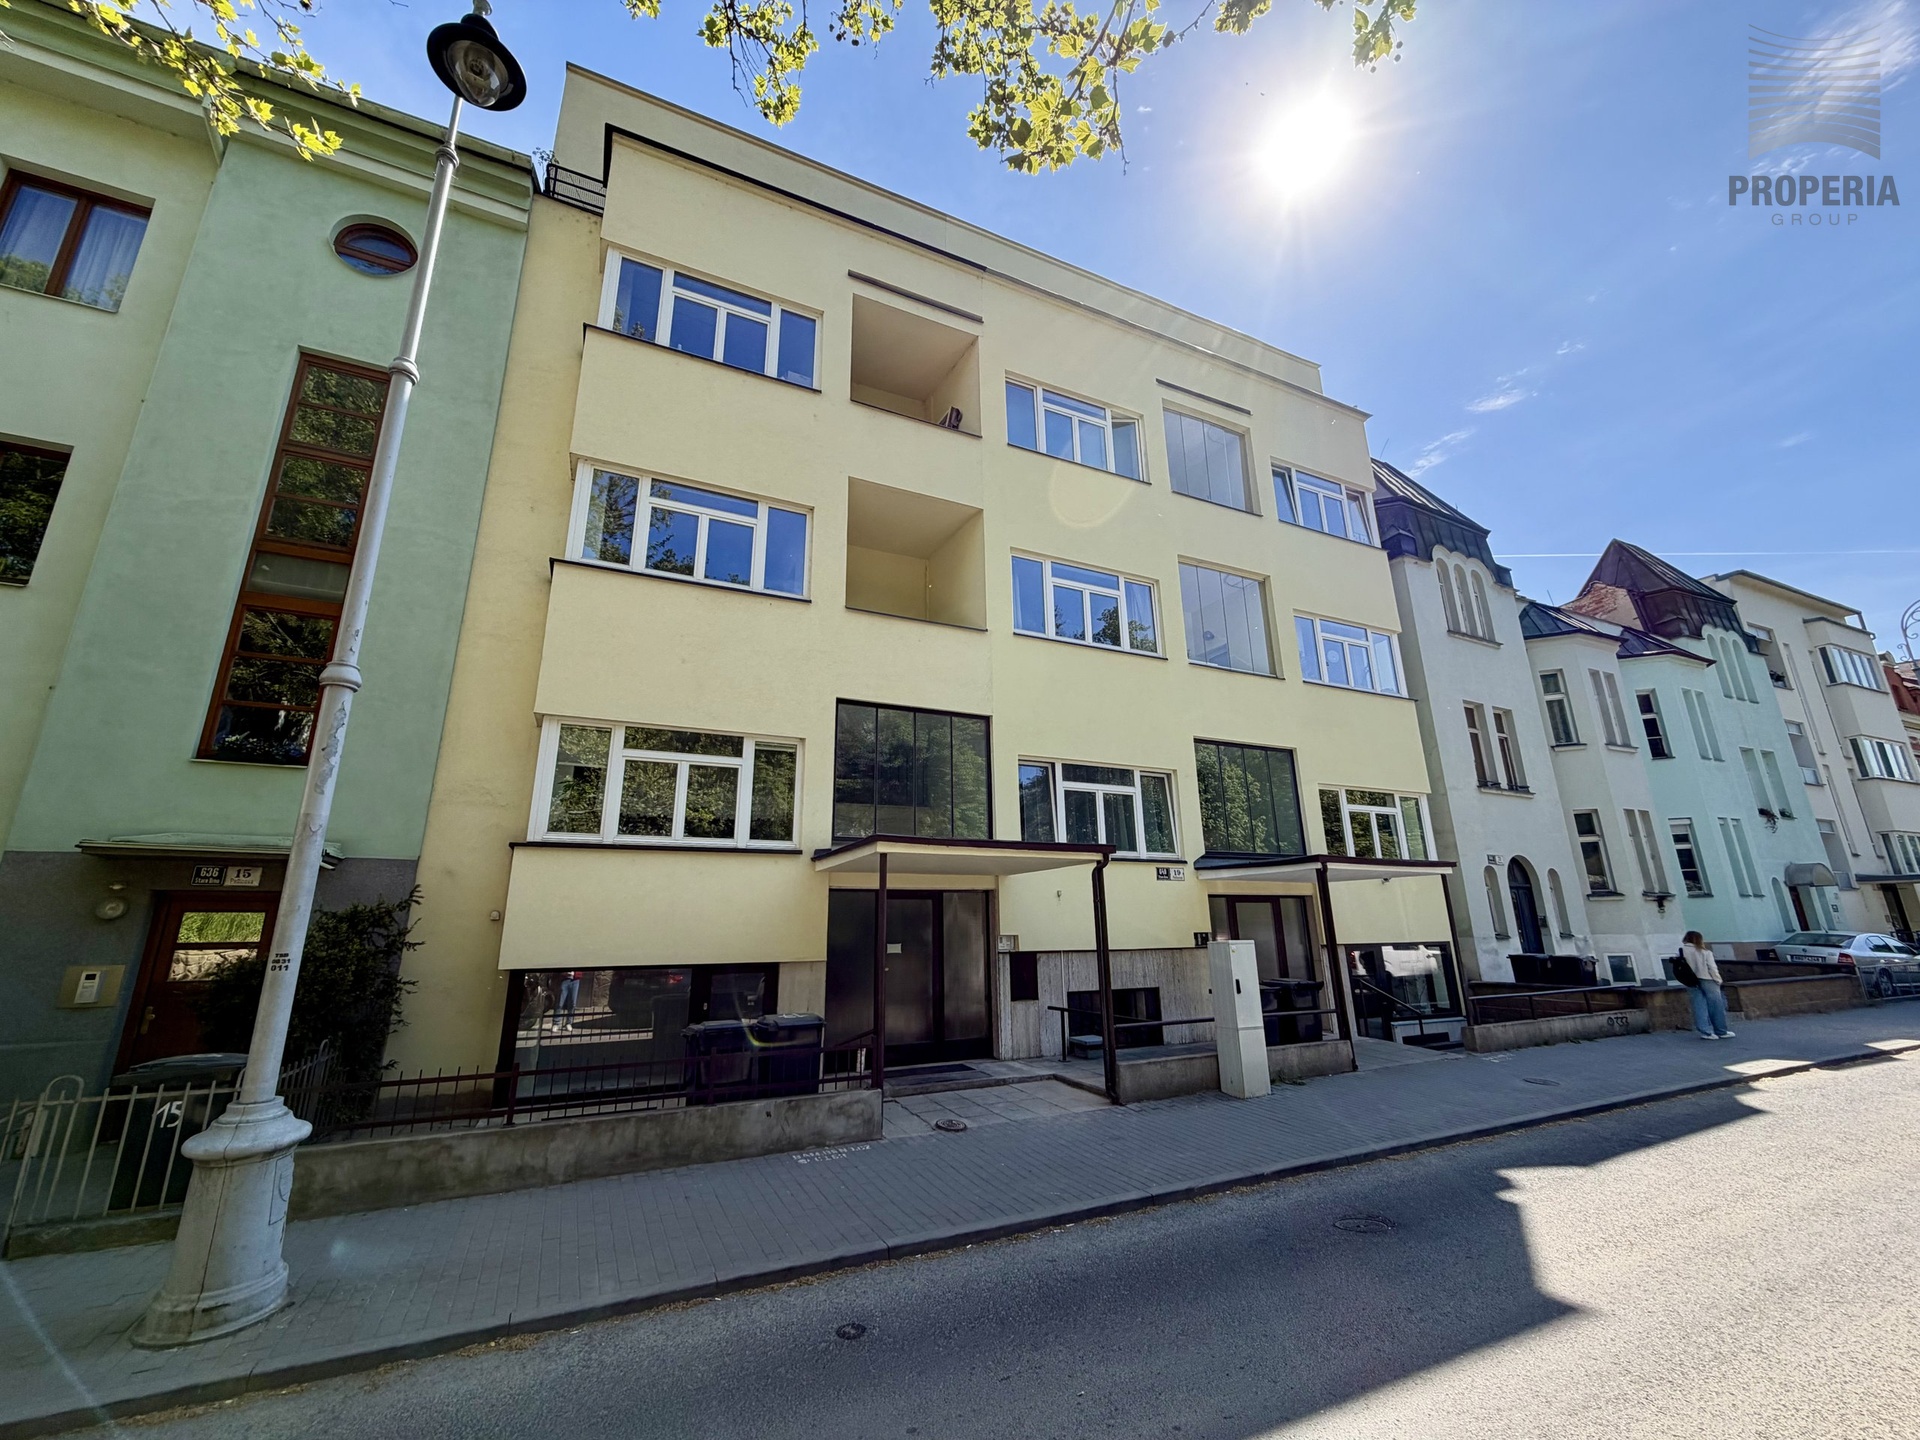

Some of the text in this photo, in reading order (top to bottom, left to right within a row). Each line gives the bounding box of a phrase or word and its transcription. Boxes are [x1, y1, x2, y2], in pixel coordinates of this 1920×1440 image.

[200, 867, 220, 877] 636
[234, 868, 252, 879] 15
[156, 1101, 183, 1128] 15
